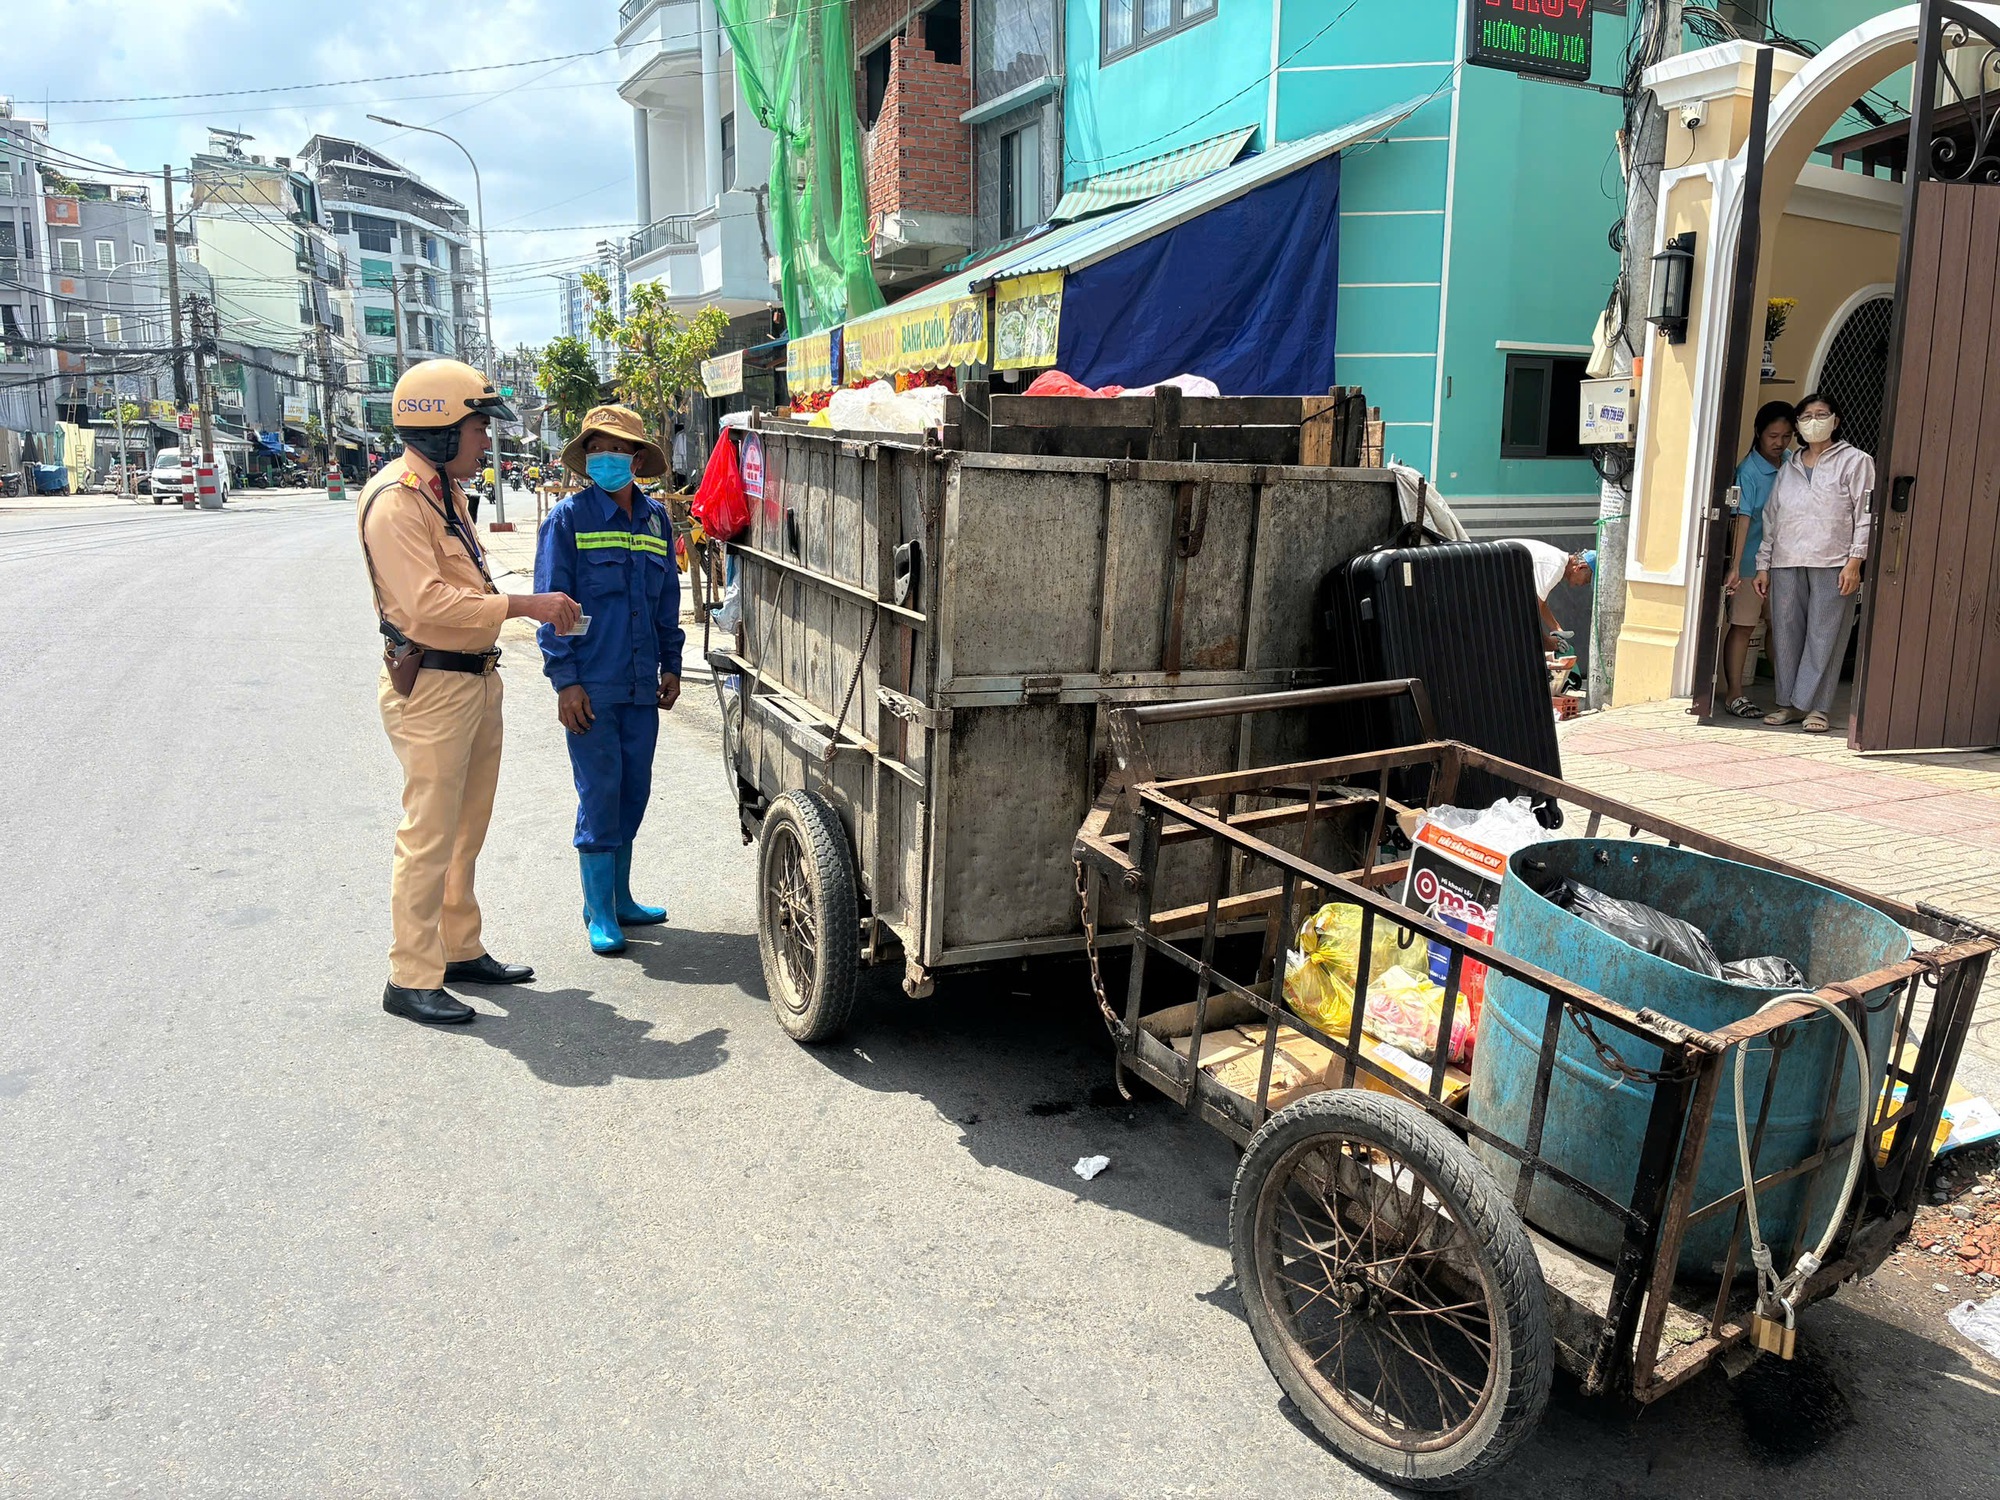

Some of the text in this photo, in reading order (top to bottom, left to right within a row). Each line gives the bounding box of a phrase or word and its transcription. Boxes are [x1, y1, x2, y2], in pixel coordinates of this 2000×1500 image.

[1483, 18, 1585, 64] HƯƠNG BÌNH XƯA
[901, 317, 922, 354] BÁNH
[923, 307, 945, 350] CUỐN
[397, 399, 446, 413] CSGT
[1464, 847, 1485, 863] CHUA
[1483, 855, 1502, 868] CAY
